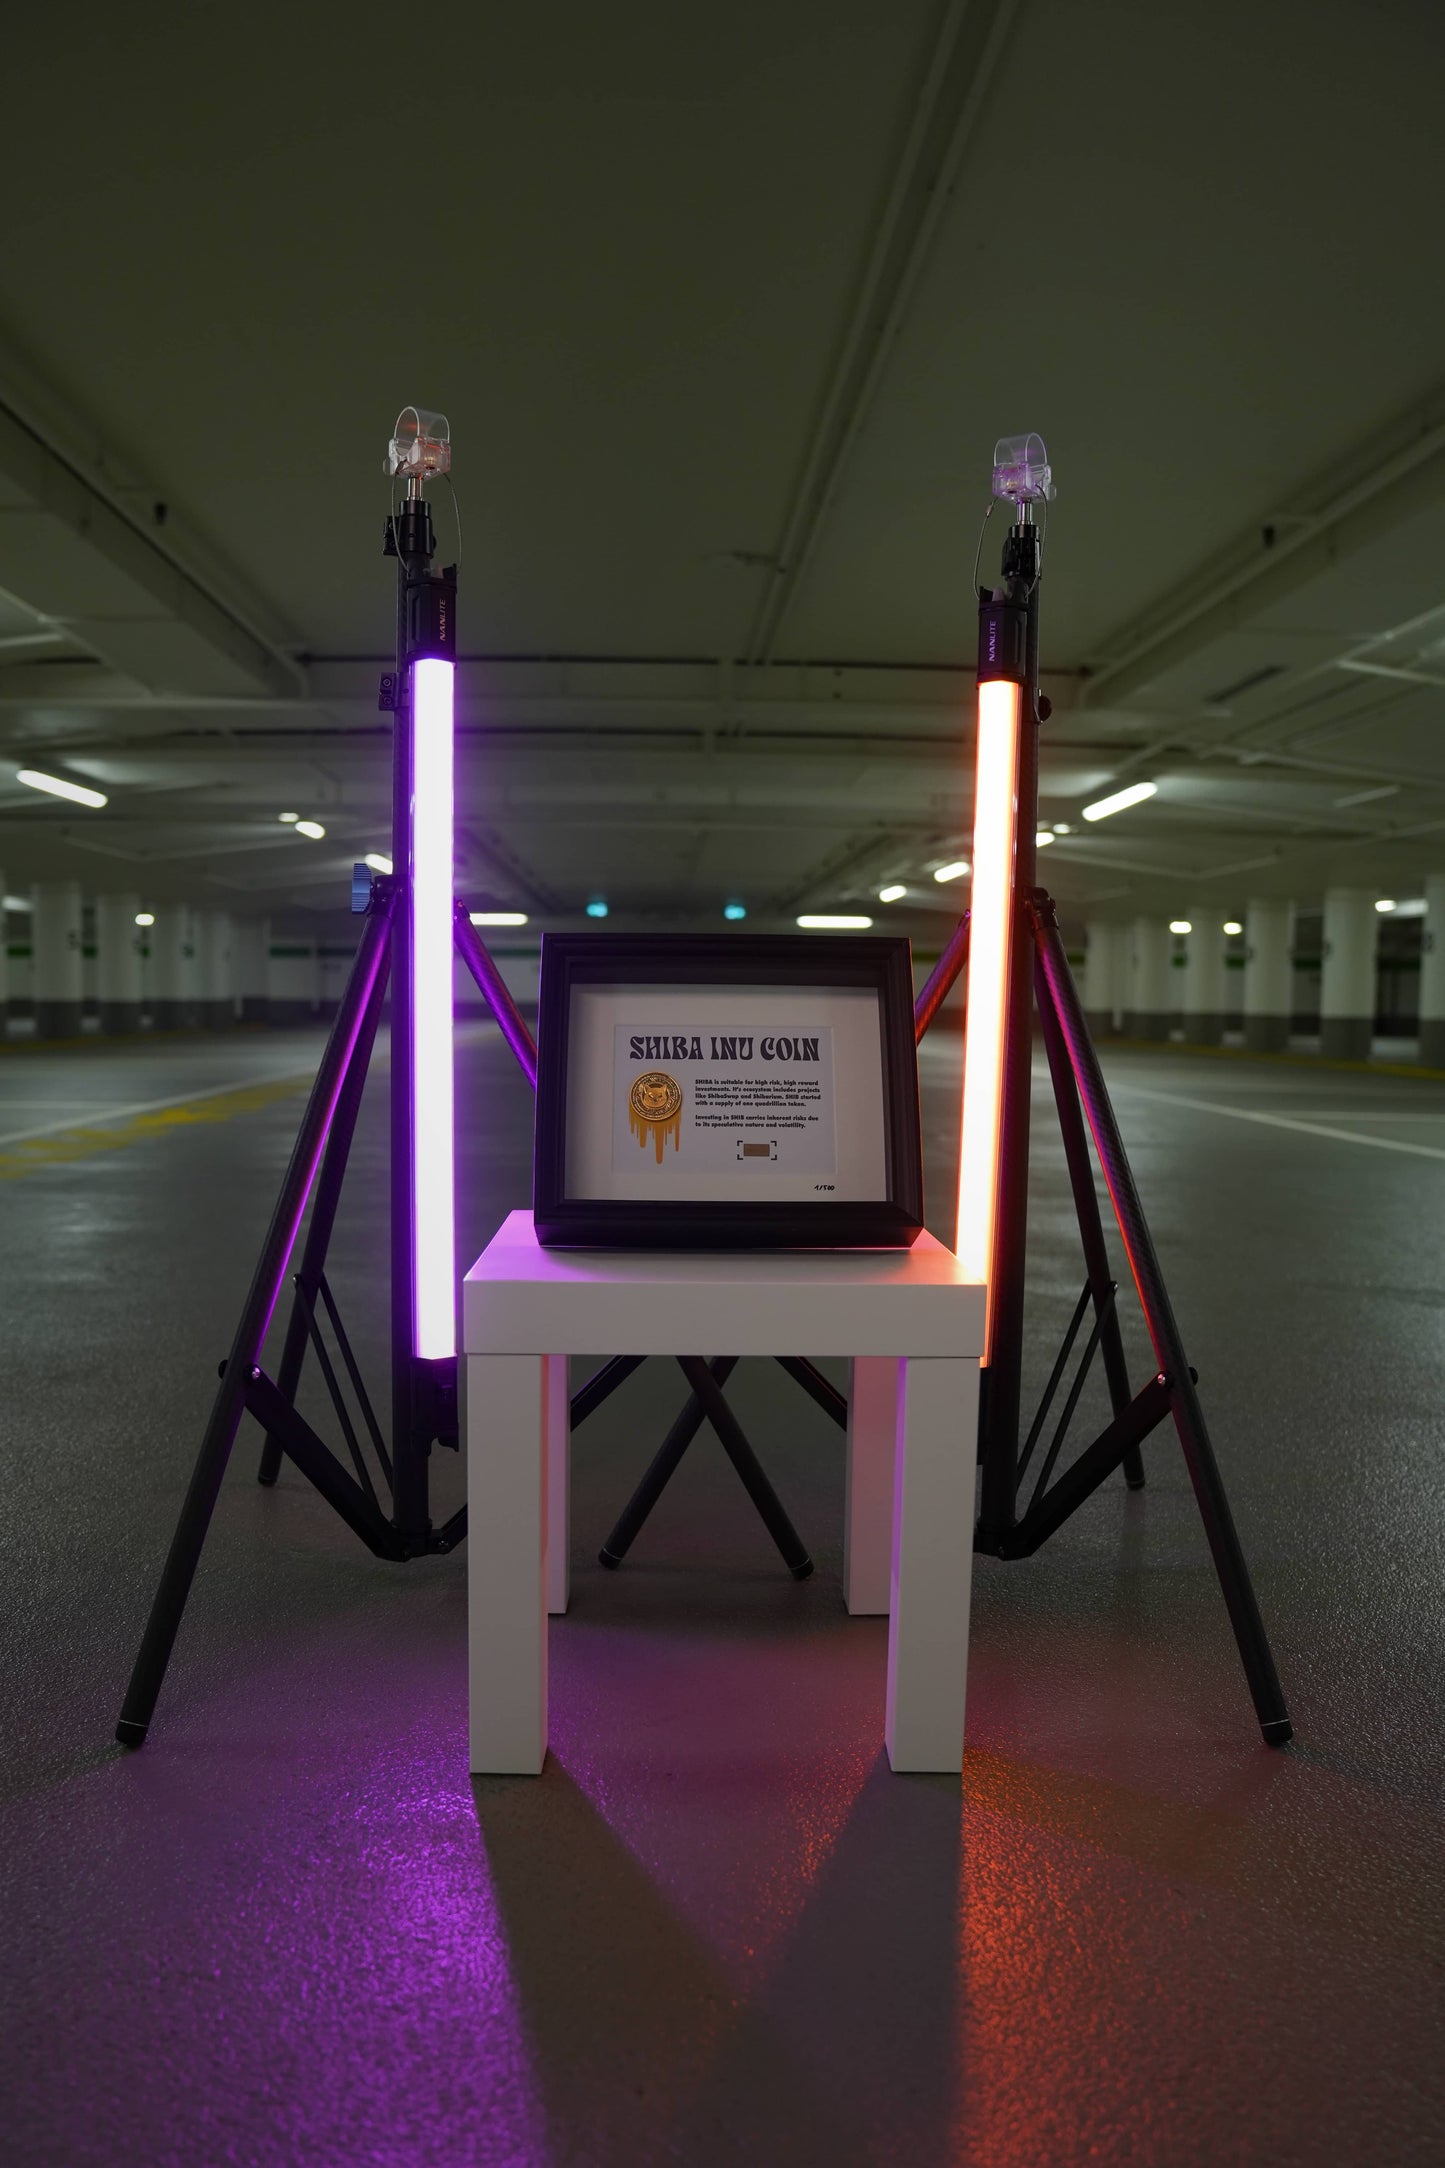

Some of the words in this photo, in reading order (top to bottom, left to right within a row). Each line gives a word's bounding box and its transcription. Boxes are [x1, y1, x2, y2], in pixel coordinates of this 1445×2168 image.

[988, 620, 996, 662] NANLITE
[629, 1036, 704, 1060] SHIBA
[710, 1036, 754, 1061] INU
[760, 1037, 820, 1061] COIN
